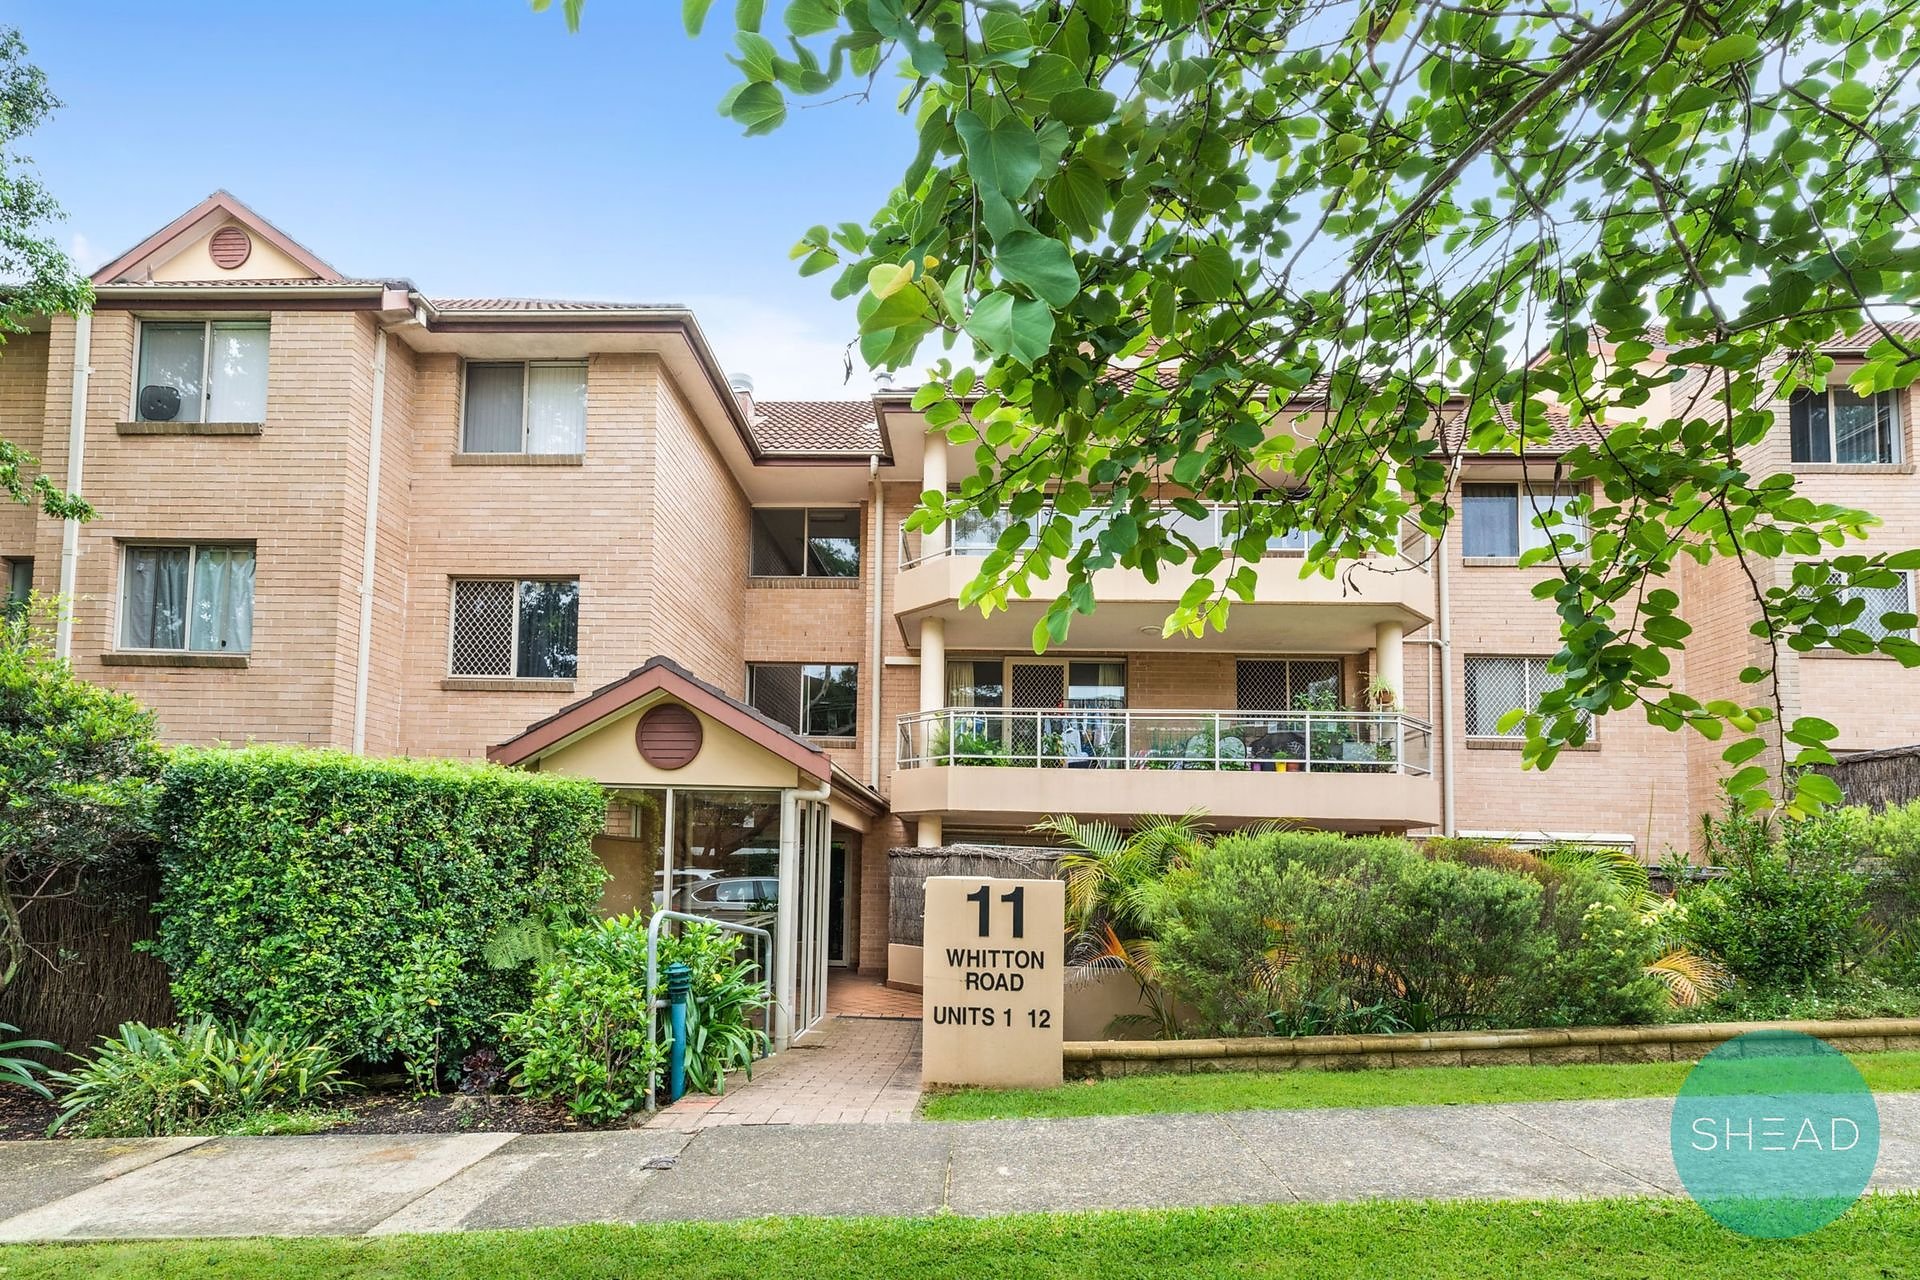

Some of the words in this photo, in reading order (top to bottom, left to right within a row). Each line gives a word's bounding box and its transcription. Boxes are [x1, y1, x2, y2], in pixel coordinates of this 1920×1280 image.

[967, 885, 1024, 938] 11
[946, 949, 1044, 969] WHITTON
[966, 972, 1024, 991] ROAD
[933, 1006, 994, 1026] UNITS
[1003, 1008, 1011, 1027] 1
[1028, 1009, 1050, 1028] 12
